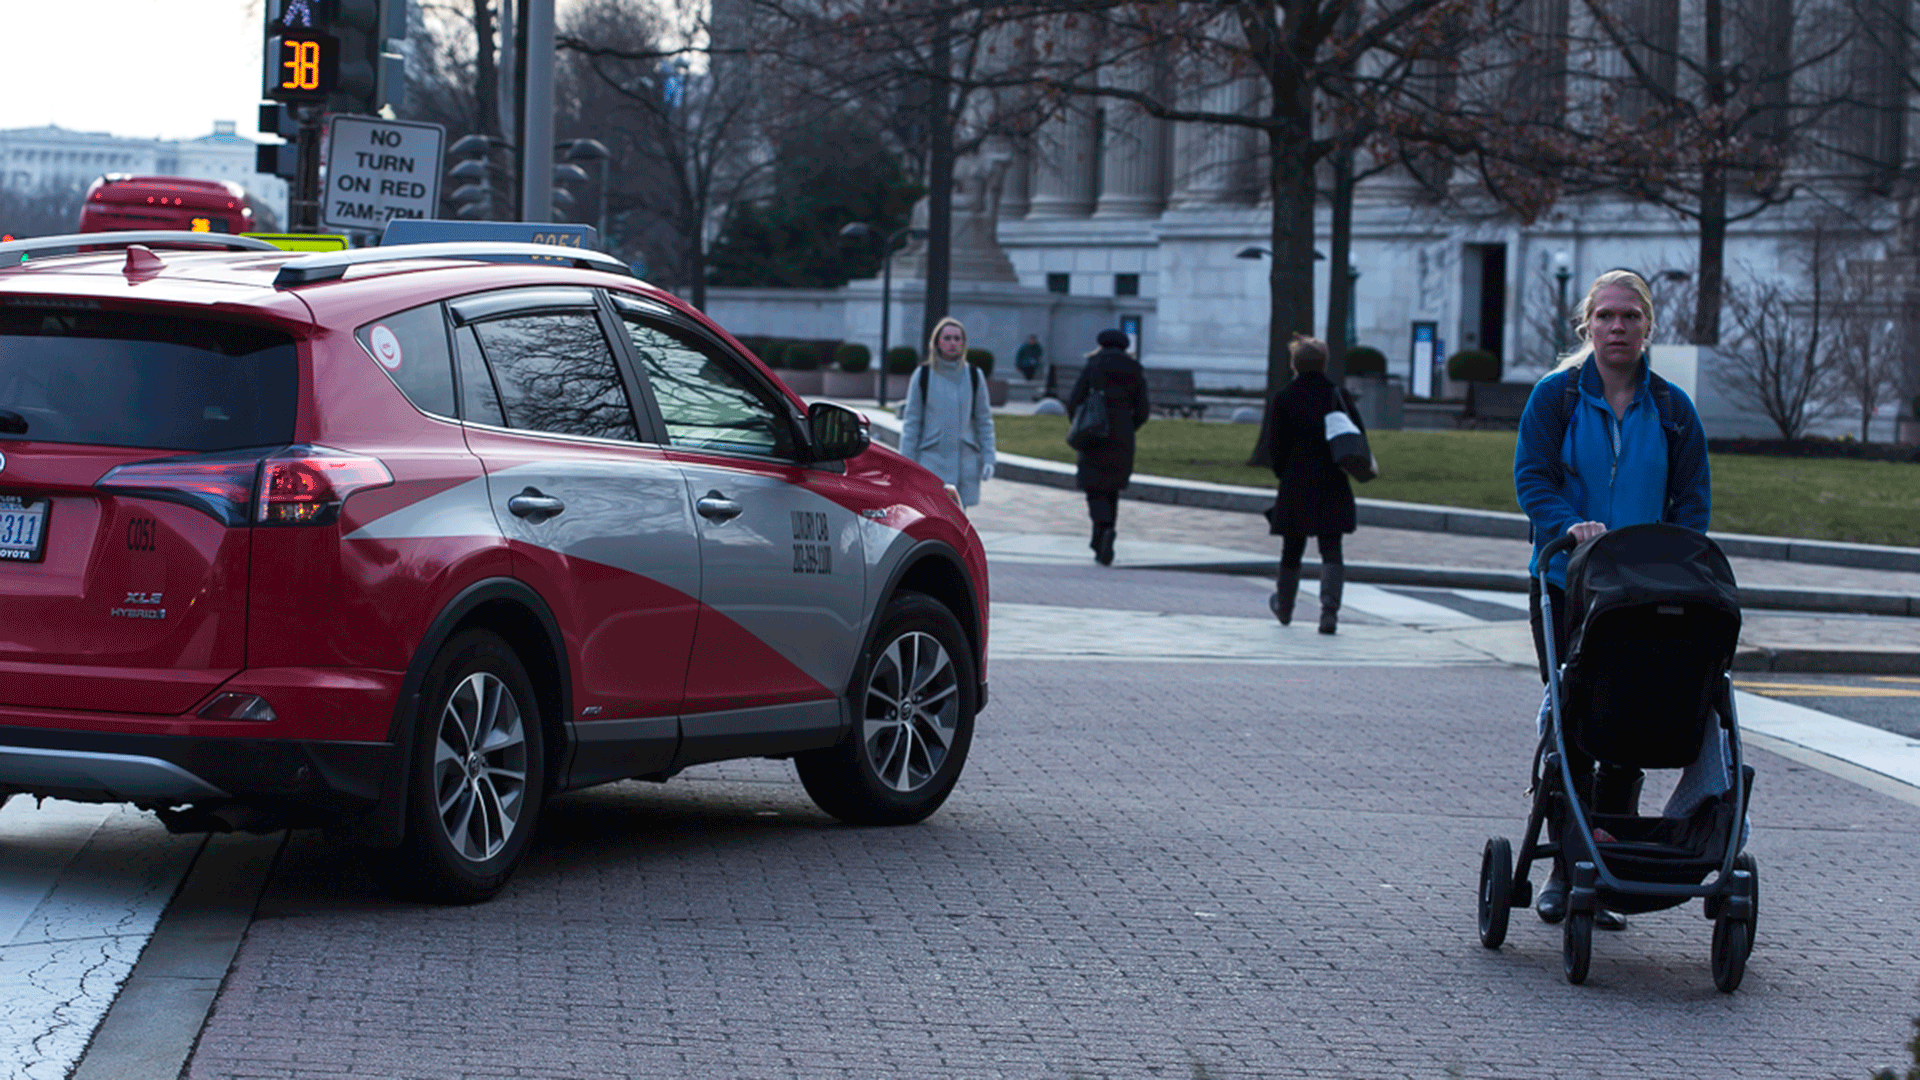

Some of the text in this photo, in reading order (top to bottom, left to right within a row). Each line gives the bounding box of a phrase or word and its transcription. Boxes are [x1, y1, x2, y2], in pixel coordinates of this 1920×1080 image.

[283, 41, 320, 89] 38
[370, 129, 402, 148] NO
[355, 151, 415, 173] TURN
[337, 174, 426, 199] ON RED
[0, 514, 36, 545] 311
[815, 511, 830, 541] CAB
[124, 592, 163, 605] XLE
[111, 607, 158, 619] HYBRID
